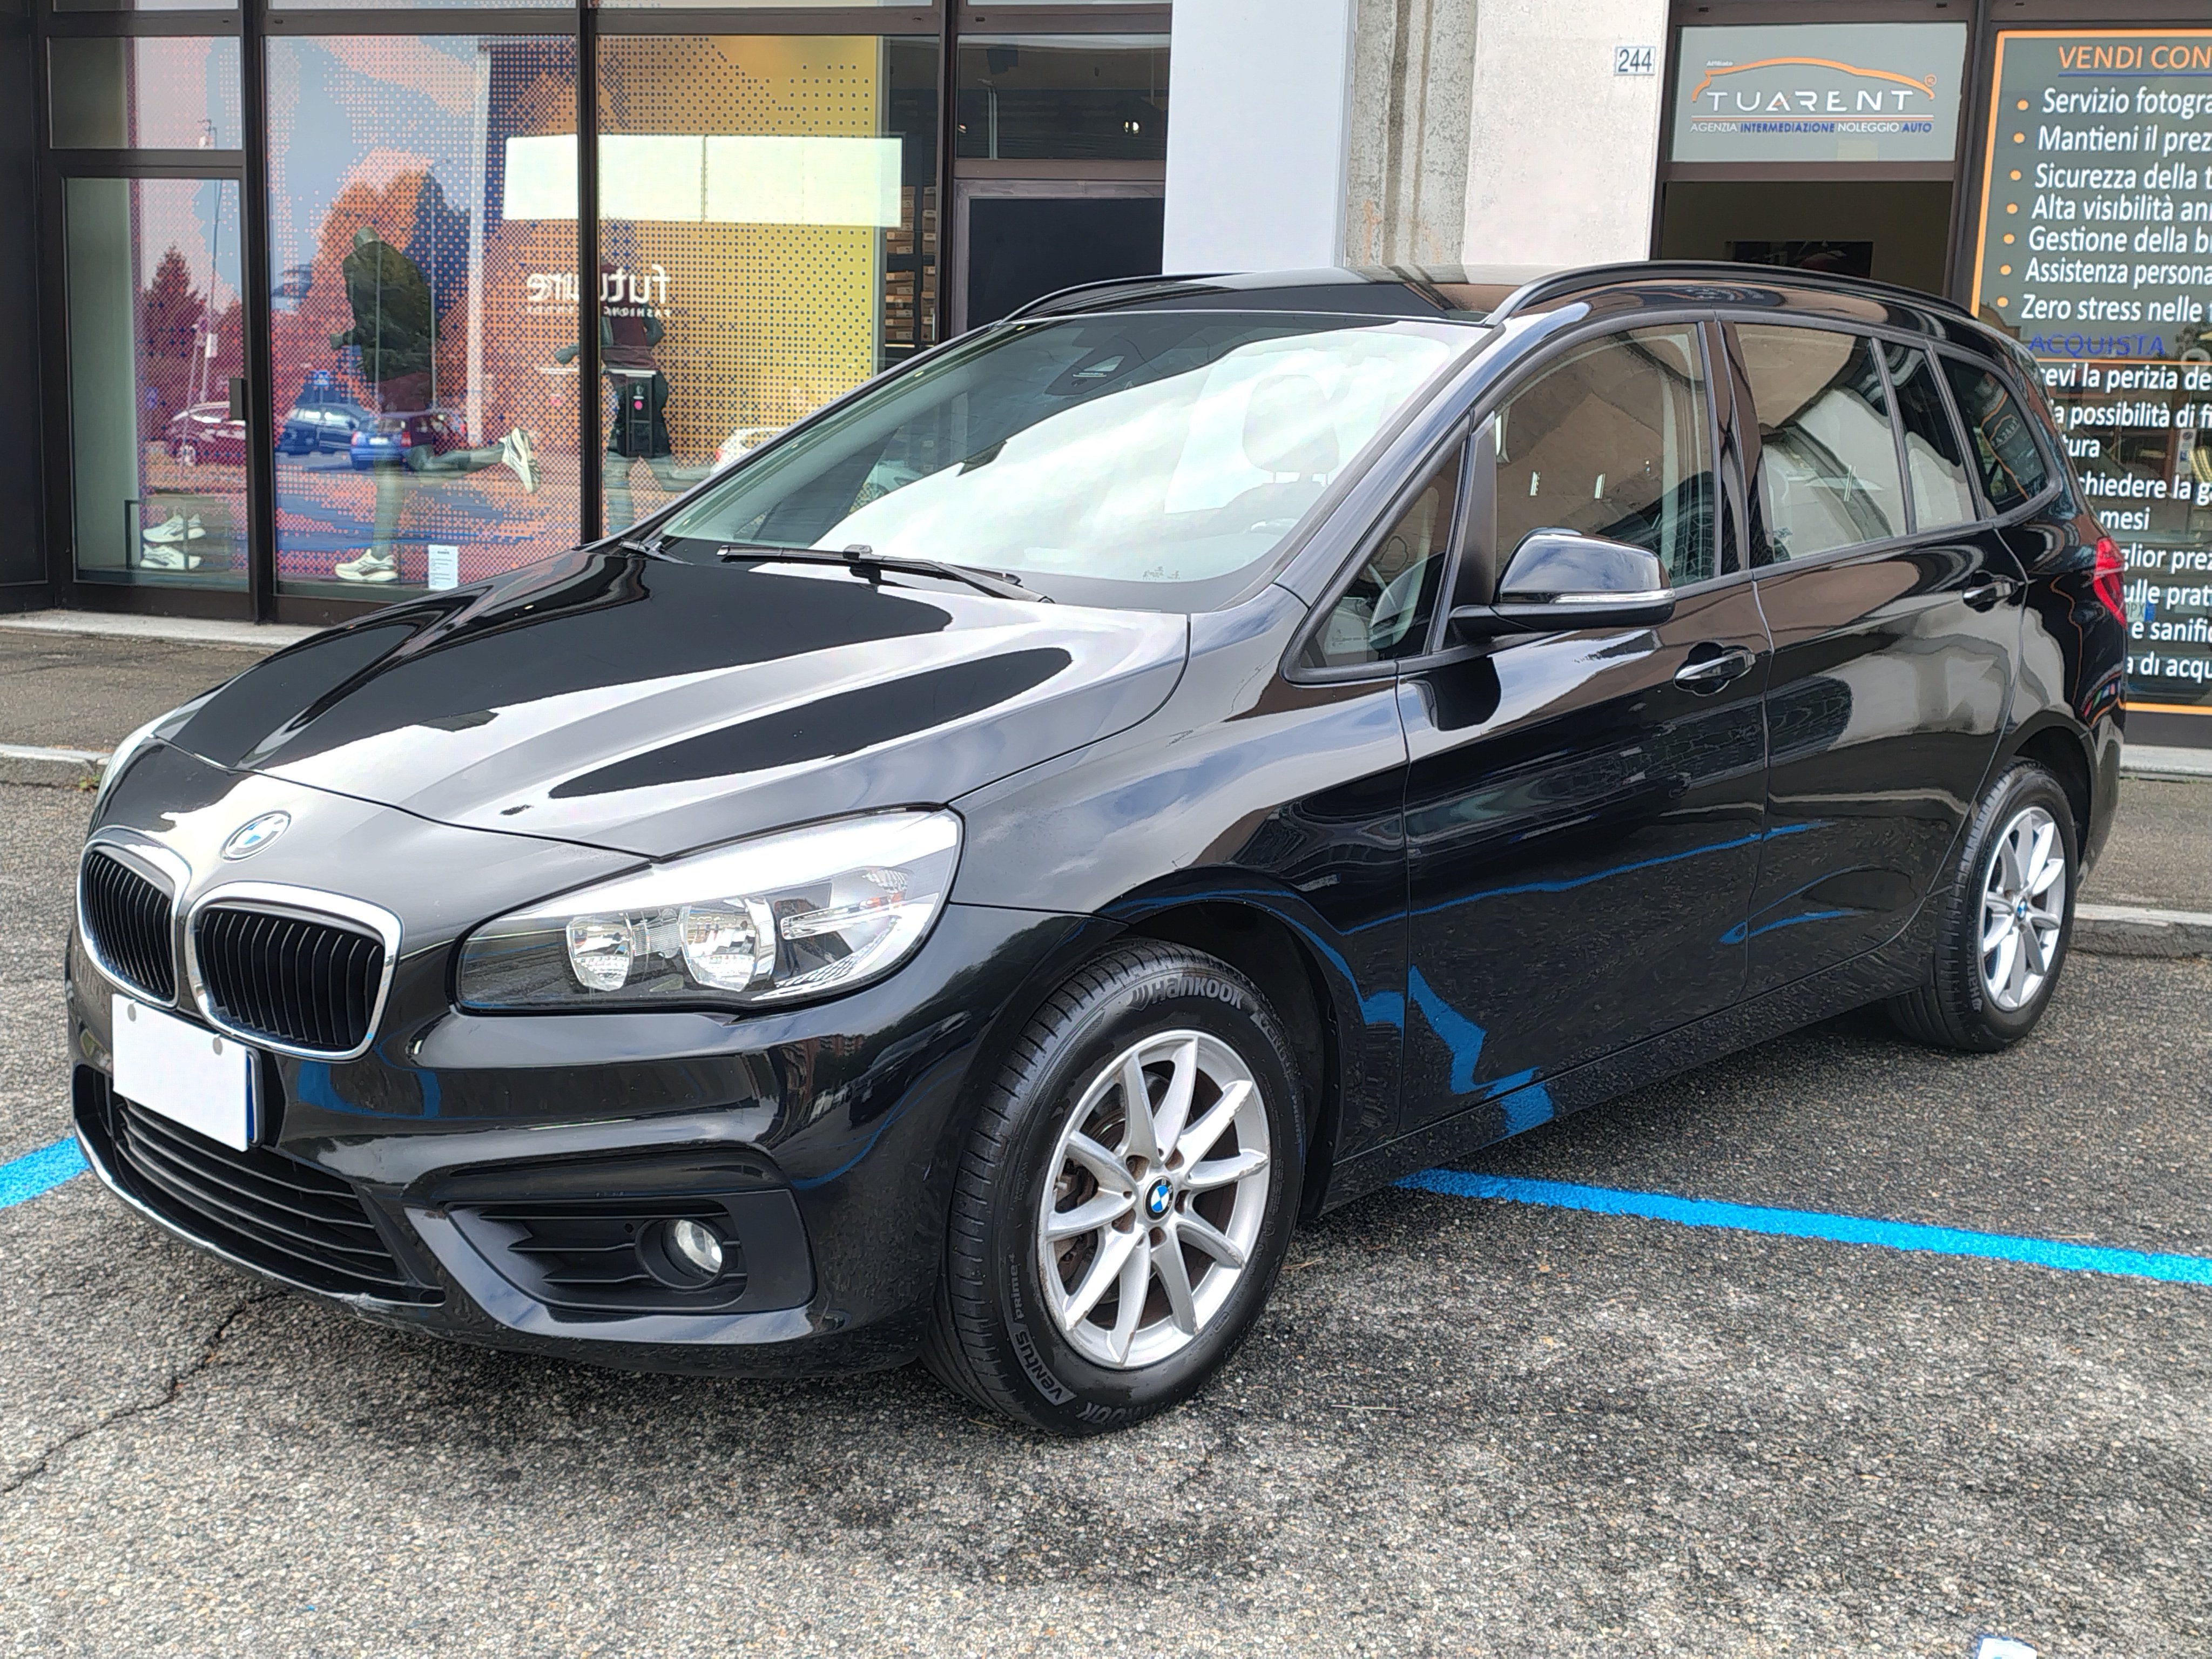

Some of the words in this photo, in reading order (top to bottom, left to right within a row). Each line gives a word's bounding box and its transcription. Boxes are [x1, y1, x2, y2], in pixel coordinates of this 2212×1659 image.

[1618, 48, 1652, 72] 244
[2058, 45, 2143, 69] VENDI
[1707, 90, 1914, 111] TUARENT
[2042, 86, 2130, 114] Servizio
[1690, 122, 1737, 133] AGENZIA
[1740, 122, 1835, 133] INTERMEDIAZIONE
[1837, 122, 1899, 133] NOLEGGIO
[1901, 123, 1932, 133] AUTO
[2038, 125, 2139, 151] Mantieni
[2144, 124, 2159, 151] il
[2163, 131, 2212, 158] prez
[2034, 162, 2137, 189] Sicurezza
[2143, 161, 2198, 190] della
[2031, 193, 2076, 220] Alta
[2082, 193, 2174, 221] visibilità
[2180, 201, 2212, 222] an
[2028, 225, 2128, 252] Gestione
[2133, 225, 2188, 253] della
[2194, 226, 2212, 253] b
[2024, 257, 2128, 284] Assistenza
[2020, 293, 2072, 320] Zero
[2076, 296, 2142, 321] stress
[2147, 294, 2203, 323] nelle
[2028, 333, 2166, 359] ACQUISTA
[2082, 362, 2101, 388] la
[2106, 365, 2179, 394] perizia
[2184, 365, 2212, 391] de
[2069, 401, 2171, 430] possibilità
[2175, 403, 2196, 428] di
[2172, 474, 2191, 500] la
[2196, 481, 2212, 507] g
[2099, 507, 2151, 530] mesi
[2131, 621, 2144, 639] e
[2140, 651, 2160, 676] di
